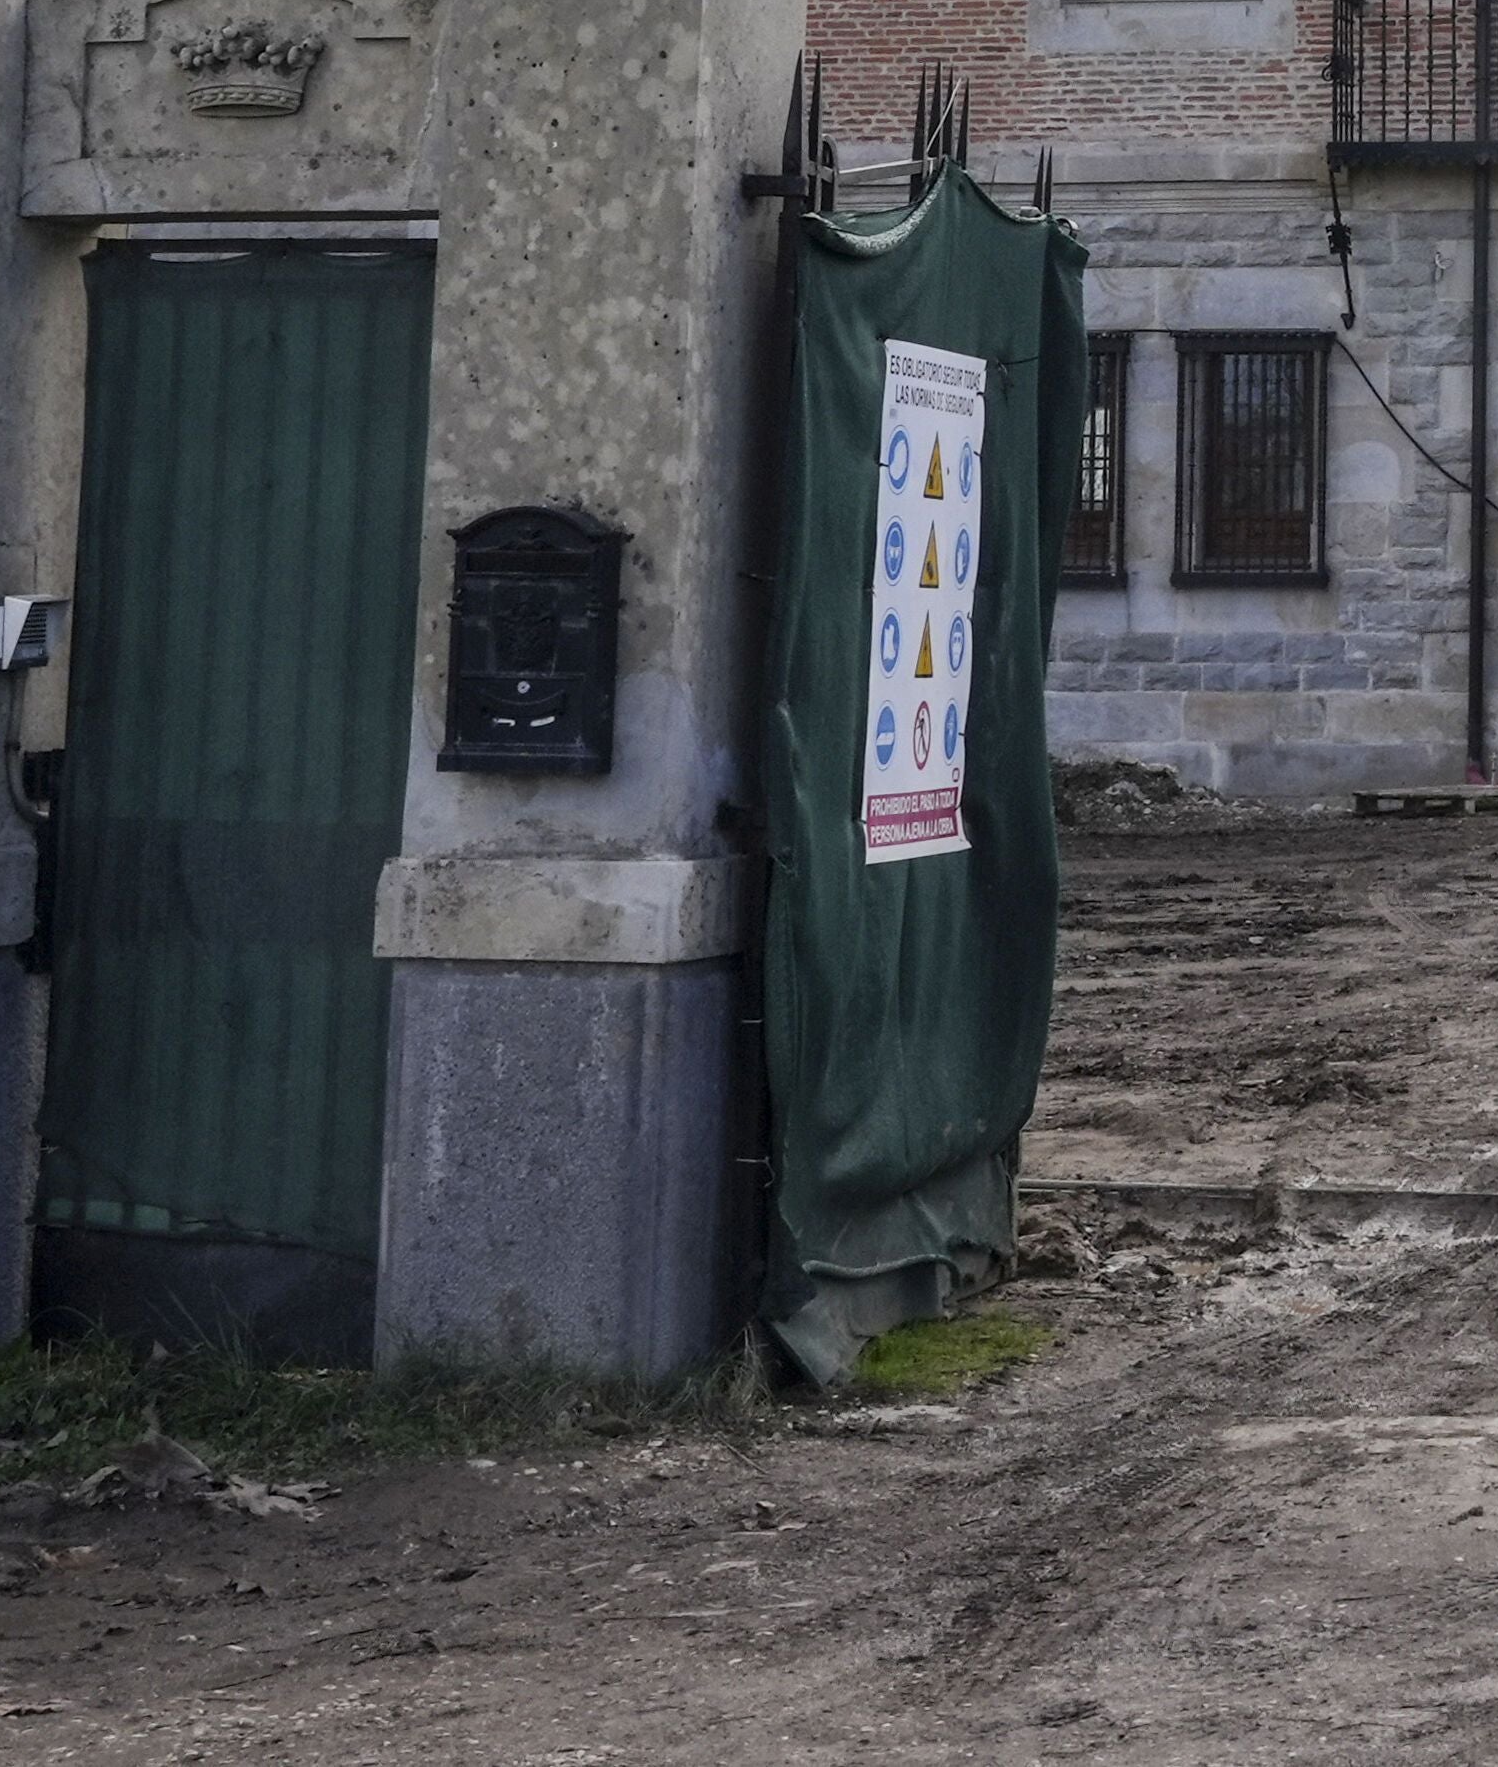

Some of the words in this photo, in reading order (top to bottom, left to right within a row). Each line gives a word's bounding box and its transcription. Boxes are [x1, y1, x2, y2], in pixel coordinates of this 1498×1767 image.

[890, 355, 901, 375] ES
[902, 357, 943, 383] OBLIGATORIO
[943, 366, 963, 386] SEGUIR
[964, 370, 981, 390] TODAS
[895, 384, 909, 404] LAS
[911, 387, 936, 409] NORMAS
[945, 394, 974, 416] SEGURIDAD
[871, 796, 911, 817] PROHIBIDO
[911, 795, 919, 812] EL
[920, 793, 935, 811] PASO
[939, 791, 954, 808] TODA
[870, 825, 905, 844] PERSONA
[905, 821, 925, 840] AJENA
[931, 819, 938, 836] LA
[938, 817, 954, 834] OBRA
